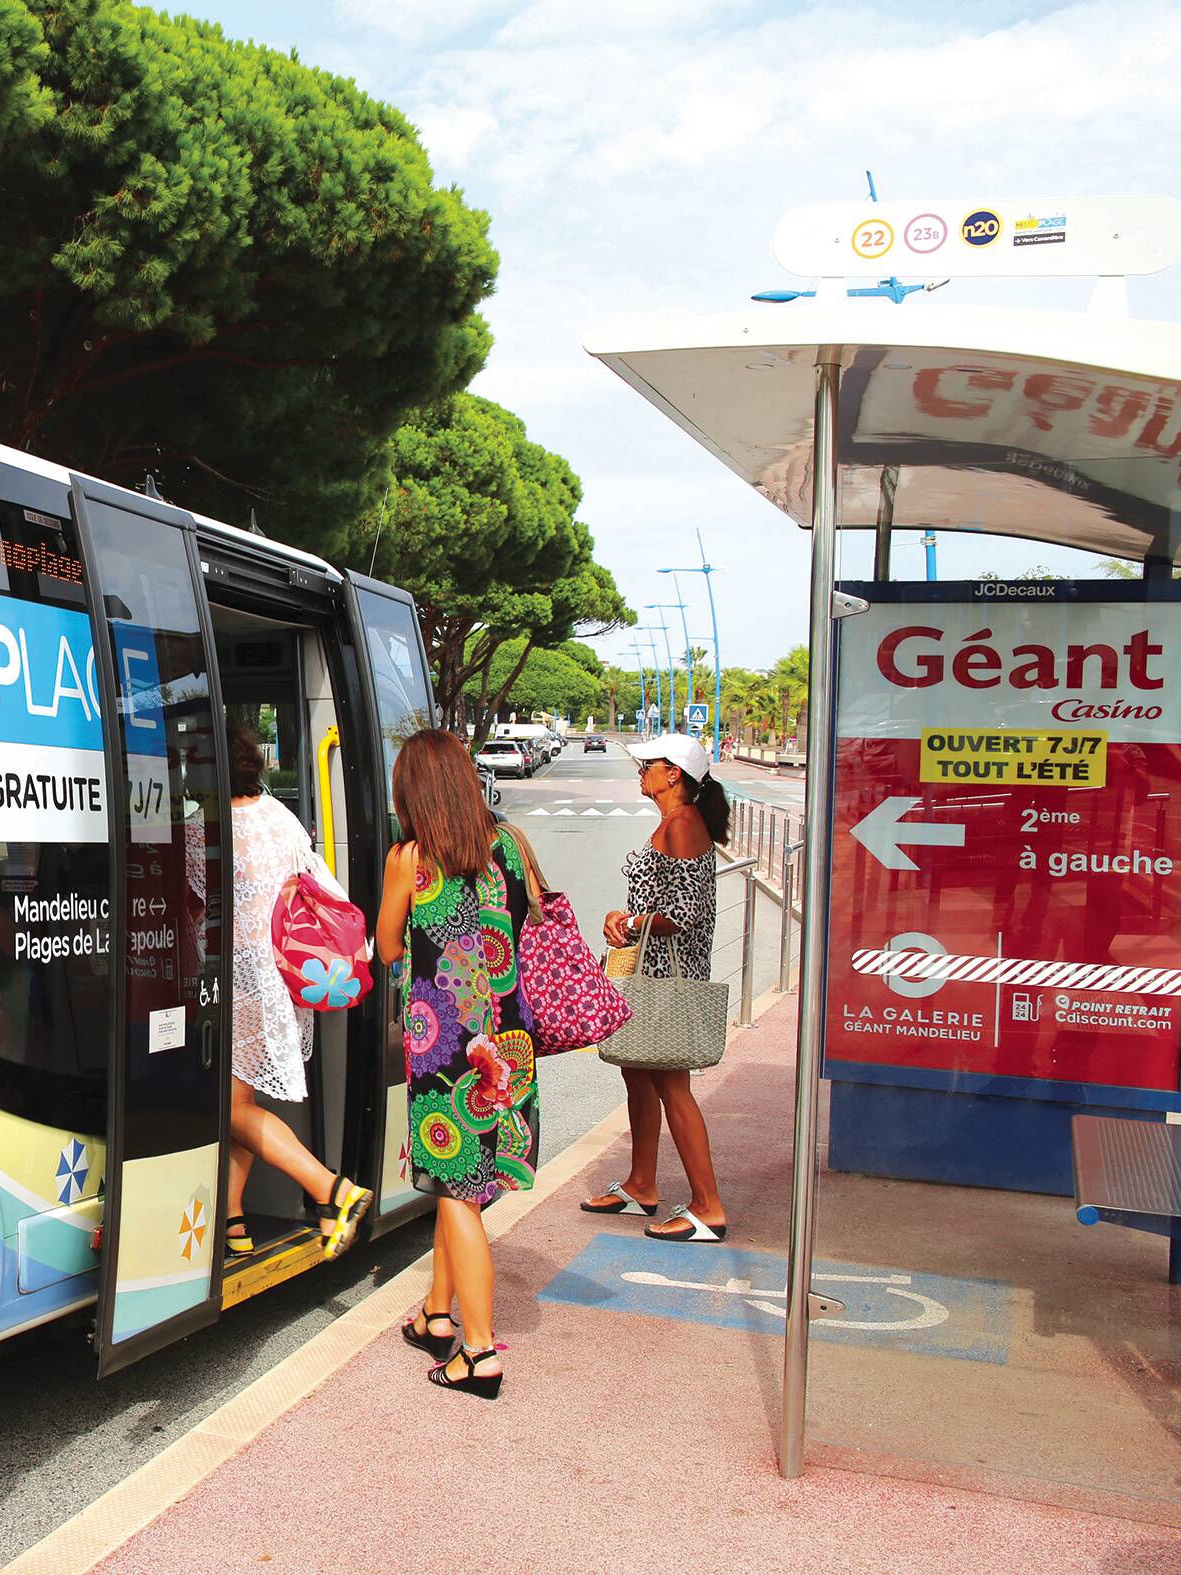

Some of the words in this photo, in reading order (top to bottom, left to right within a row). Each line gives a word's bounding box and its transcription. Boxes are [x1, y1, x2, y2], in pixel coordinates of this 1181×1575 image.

[861, 230, 885, 248] 22
[914, 228, 939, 241] 23B
[963, 220, 1000, 239] n20
[975, 582, 1055, 598] JCDecaux
[876, 625, 1164, 691] Géant
[1051, 698, 1163, 723] Casino
[927, 734, 1036, 754] OUVERT
[1047, 736, 1102, 757] 7J/7
[937, 760, 1009, 779] TOUT
[1017, 760, 1090, 781] L'ÉTÉ
[1020, 806, 1081, 833] 2ème
[1019, 845, 1038, 871] à
[1049, 848, 1173, 877] gauche
[14, 893, 97, 923] Mandelieu
[15, 931, 70, 964] Plages
[73, 928, 93, 956] de
[843, 1004, 873, 1019] LA
[883, 1007, 983, 1028] GALERIE
[1055, 1010, 1172, 1030] Cdiscount.com
[1071, 1001, 1113, 1016] POINT
[1116, 1004, 1172, 1017] RETRAIT
[844, 1020, 890, 1036] GÉANT
[896, 1025, 981, 1042] MANDELIEU
